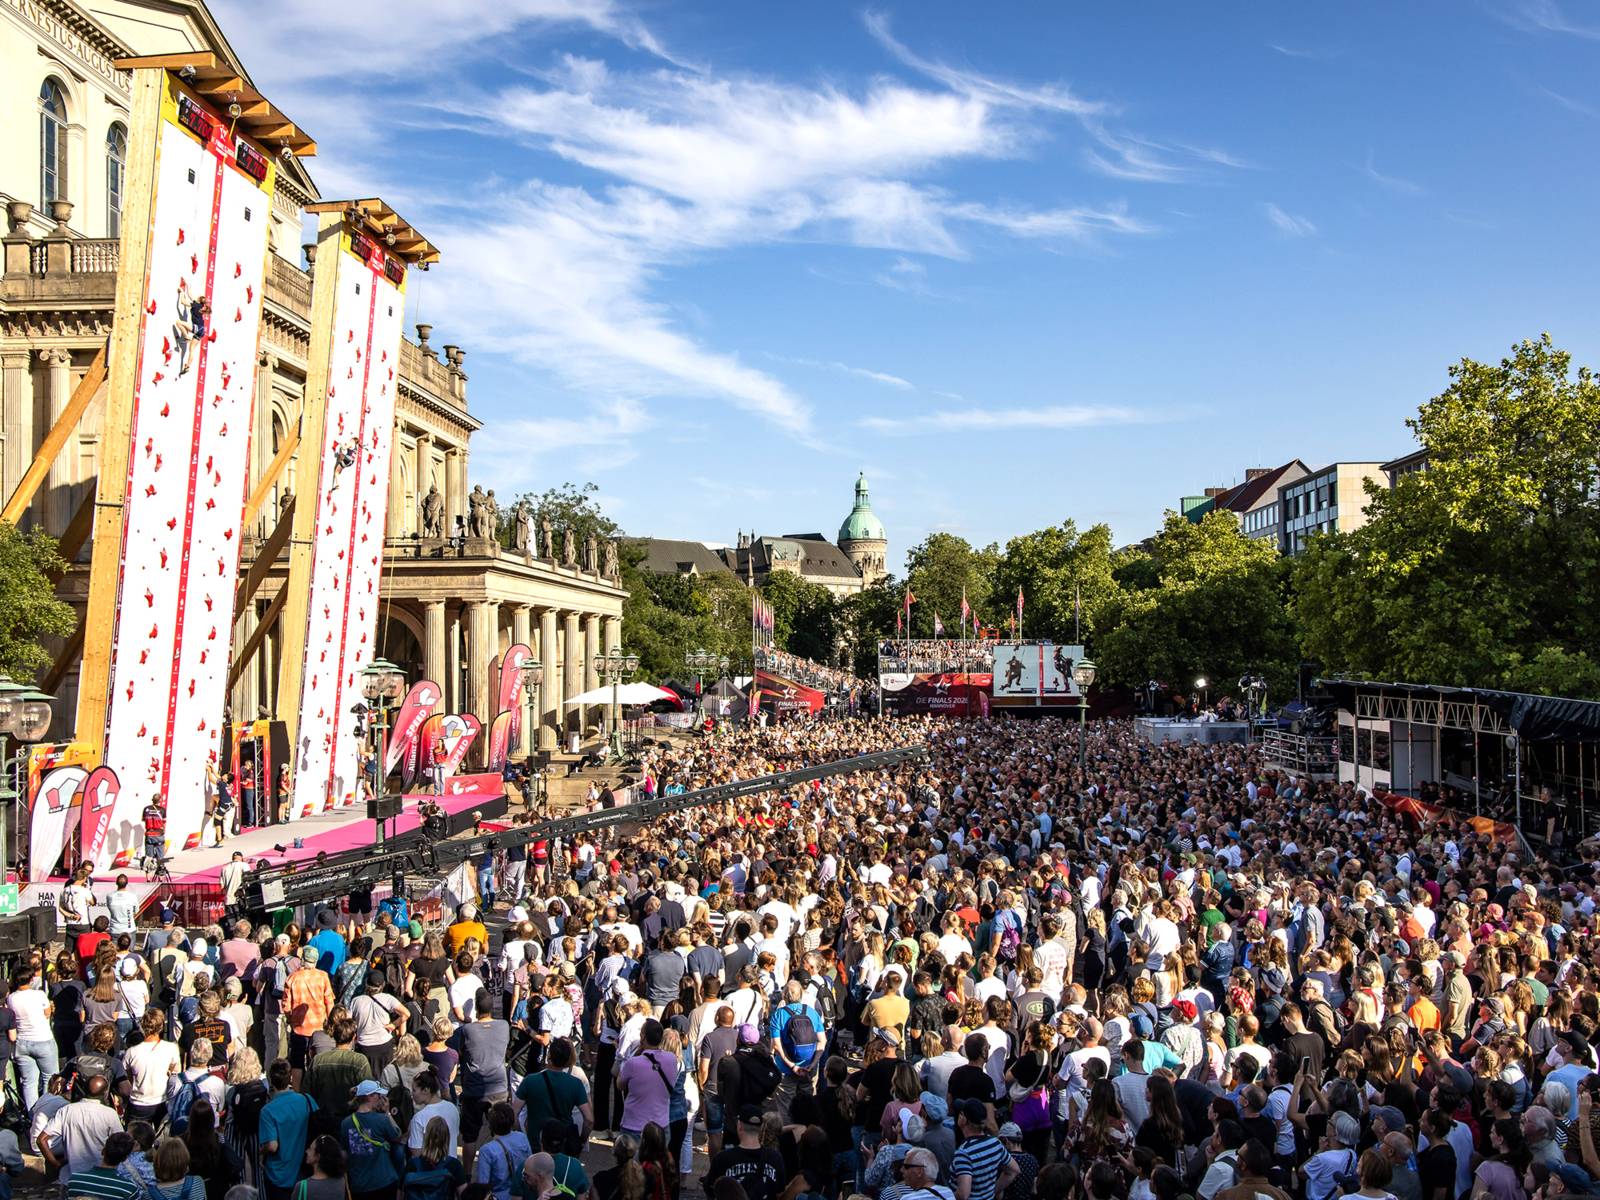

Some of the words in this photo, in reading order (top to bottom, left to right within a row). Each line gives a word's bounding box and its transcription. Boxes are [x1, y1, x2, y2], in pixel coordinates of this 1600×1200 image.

[406, 709, 427, 738] SPEED
[408, 741, 417, 771] Allianz
[451, 739, 469, 765] SPEED
[89, 812, 108, 861] SPEED
